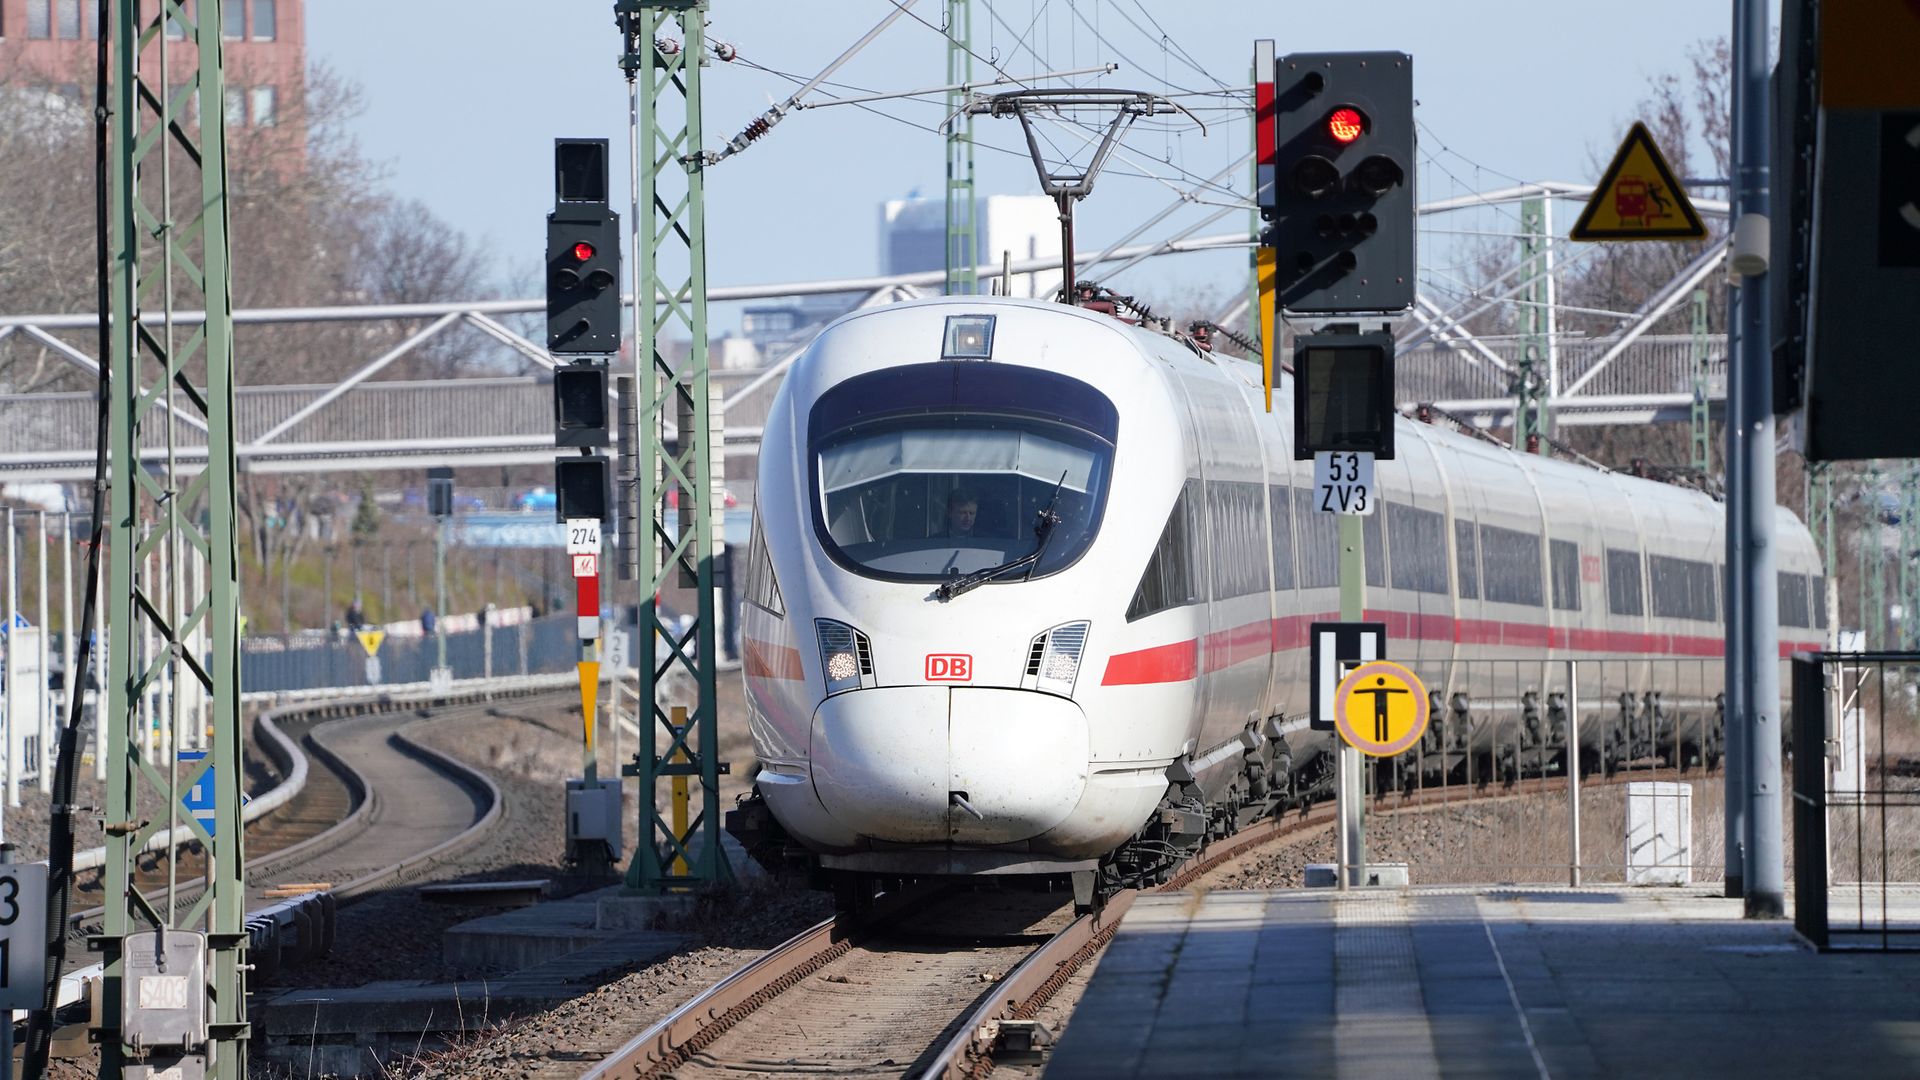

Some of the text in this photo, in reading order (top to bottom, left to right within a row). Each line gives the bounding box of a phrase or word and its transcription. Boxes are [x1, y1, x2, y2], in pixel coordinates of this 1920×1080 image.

[1330, 454, 1358, 482] 53
[1321, 484, 1366, 512] ZV3
[572, 528, 597, 545] 274
[930, 657, 968, 677] DB
[143, 978, 185, 1006] S403
